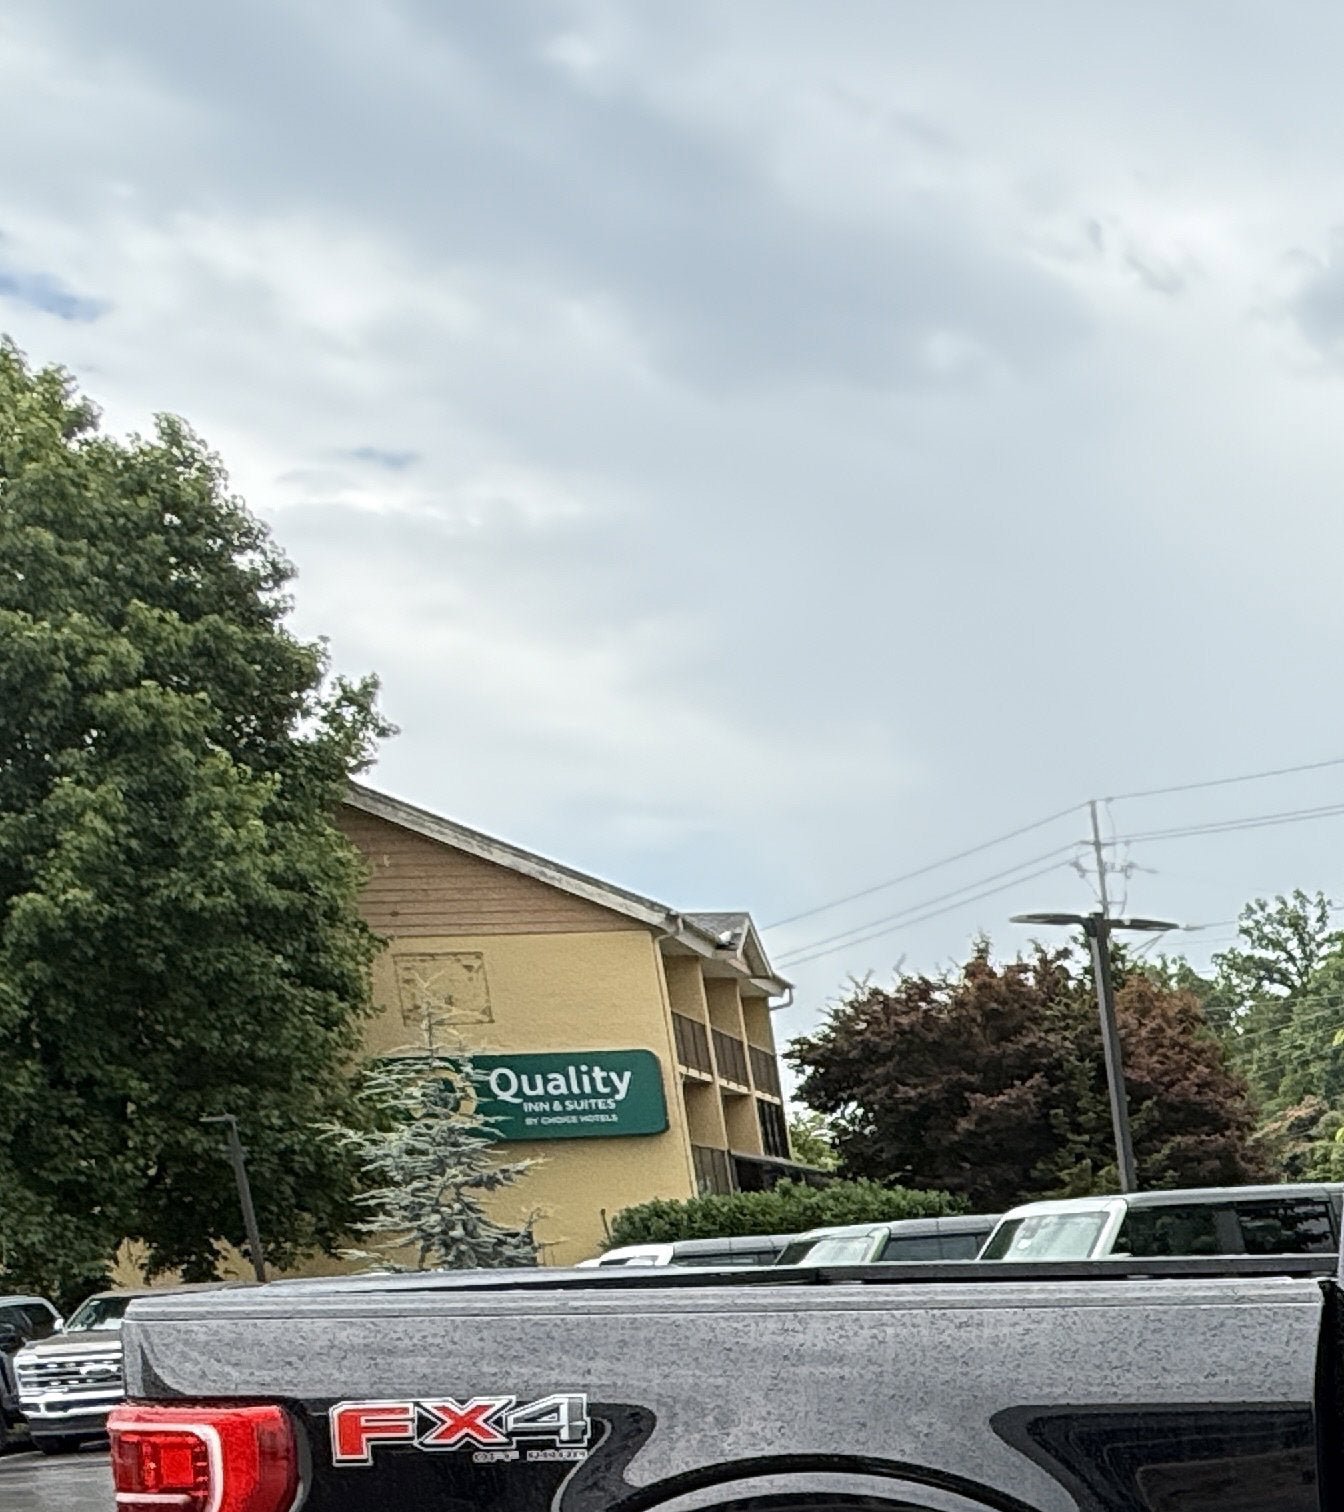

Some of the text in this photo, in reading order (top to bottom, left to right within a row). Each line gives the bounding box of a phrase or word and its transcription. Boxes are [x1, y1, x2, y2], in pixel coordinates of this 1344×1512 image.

[489, 1064, 632, 1104] Quality
[523, 1098, 616, 1113] INN & SUITES
[328, 1392, 592, 1467] FX4
